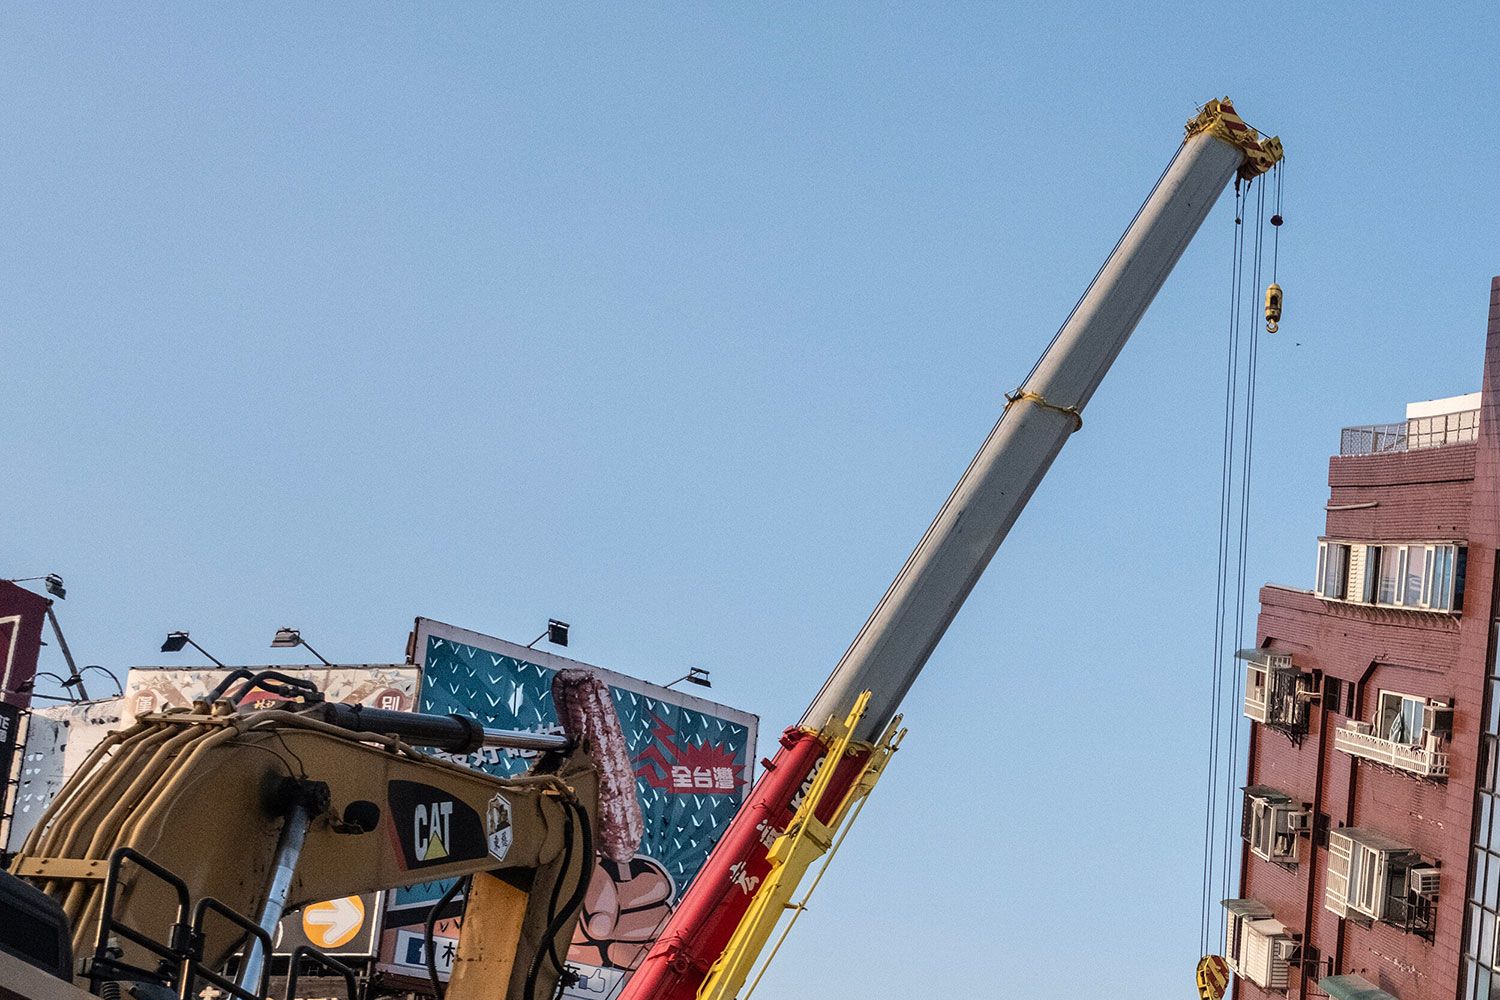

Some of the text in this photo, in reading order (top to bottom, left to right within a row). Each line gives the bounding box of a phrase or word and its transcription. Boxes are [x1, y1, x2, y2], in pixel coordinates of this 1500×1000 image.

[671, 765, 734, 789] 全台灣
[414, 801, 453, 861] CAT
